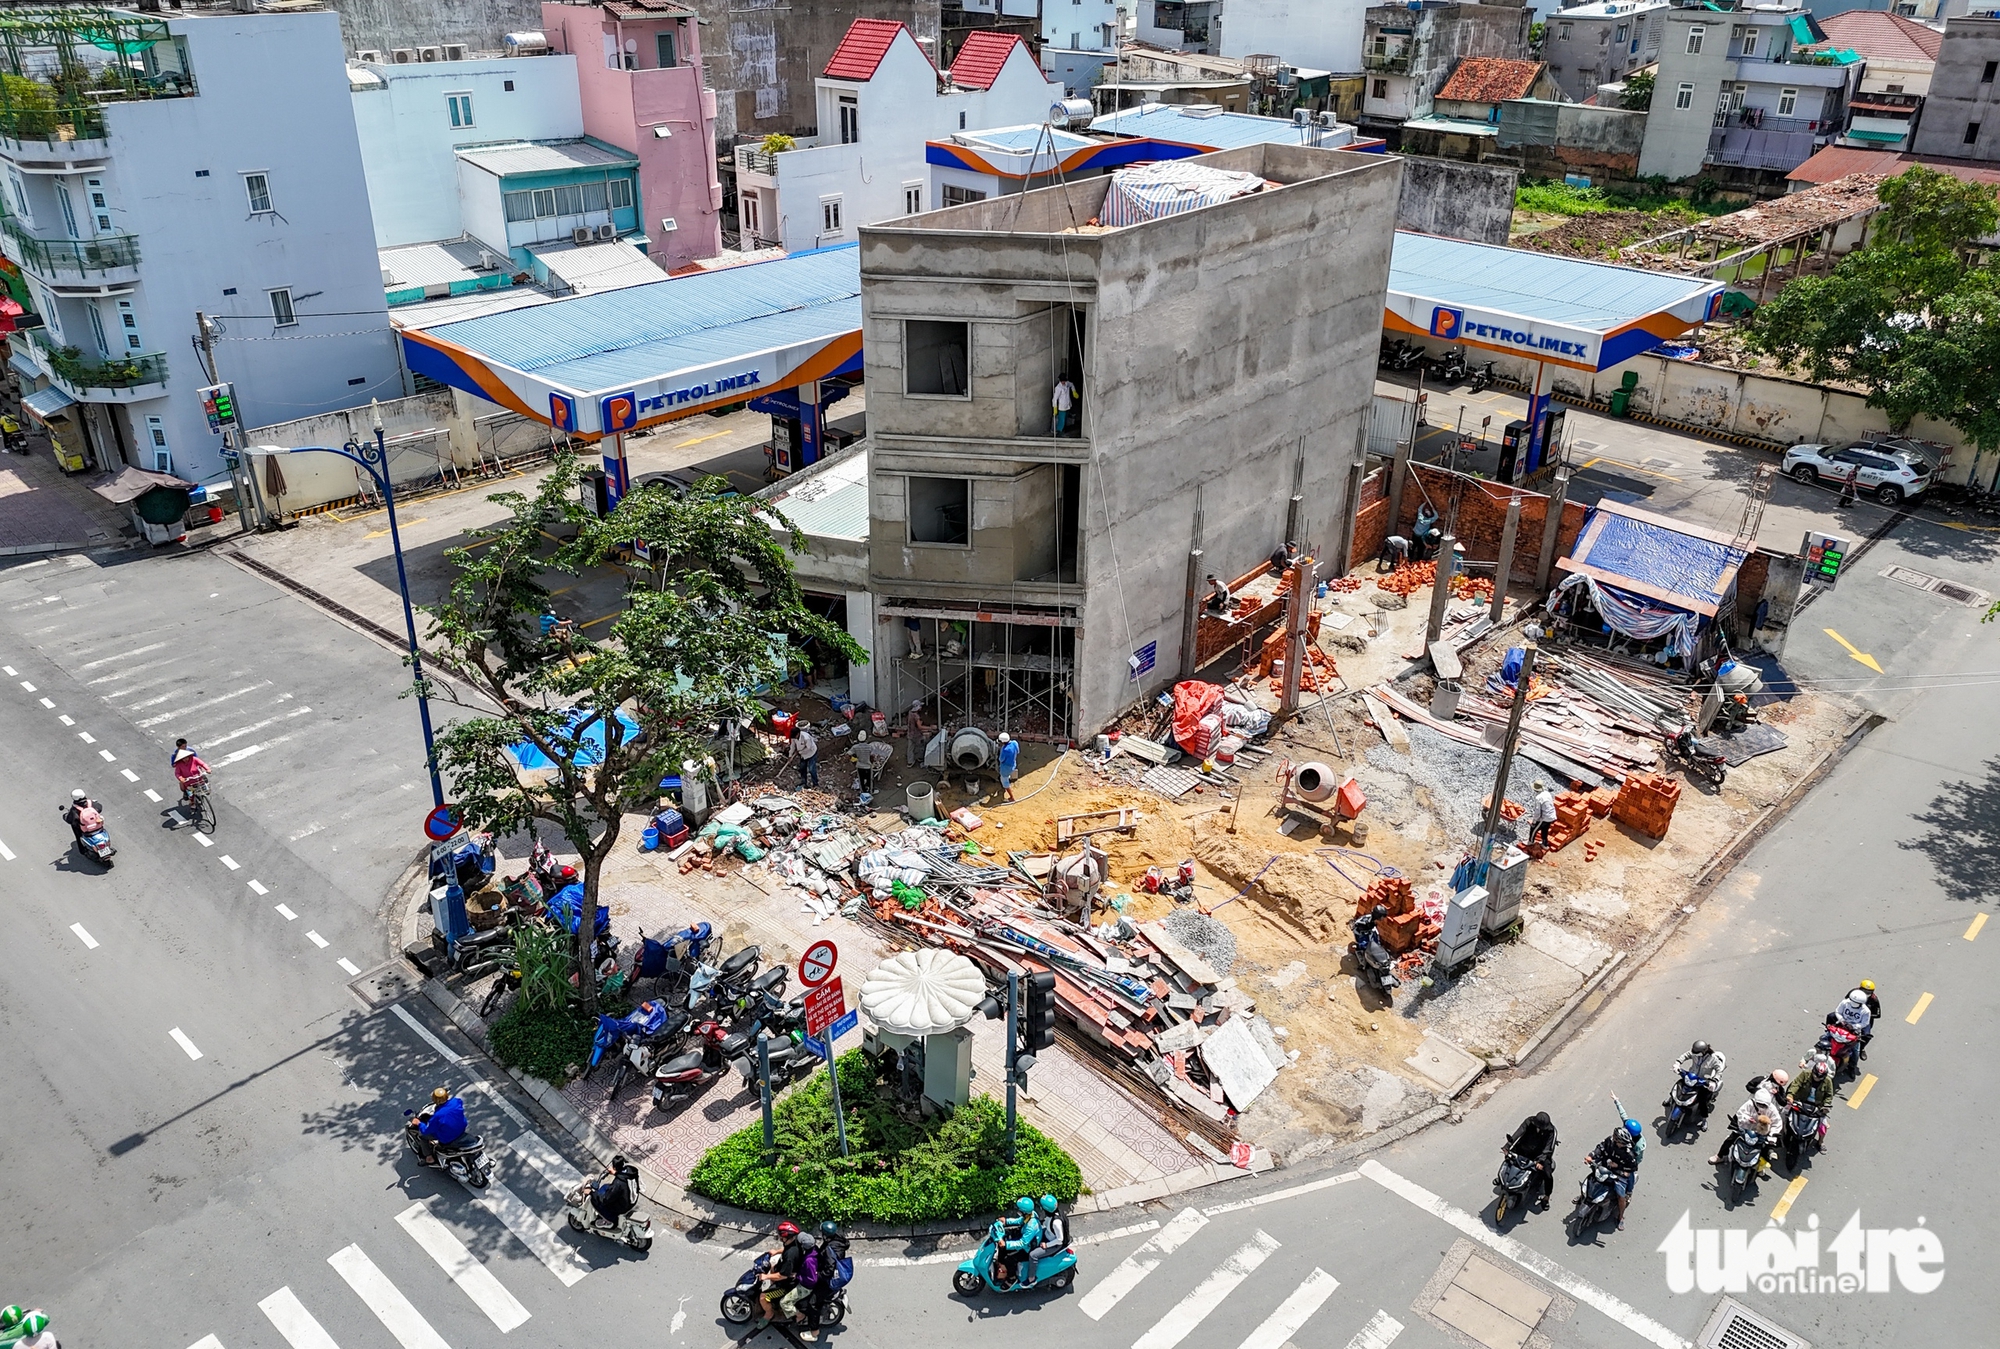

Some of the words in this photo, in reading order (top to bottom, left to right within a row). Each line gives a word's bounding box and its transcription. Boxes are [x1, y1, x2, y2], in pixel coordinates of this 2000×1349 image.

[1464, 321, 1588, 358] PETROLIMEX
[638, 369, 760, 414] PETROLIMEX
[770, 400, 800, 412] PETROLIMEX
[816, 986, 831, 1000] CẤM
[1844, 1008, 1860, 1020] D&G
